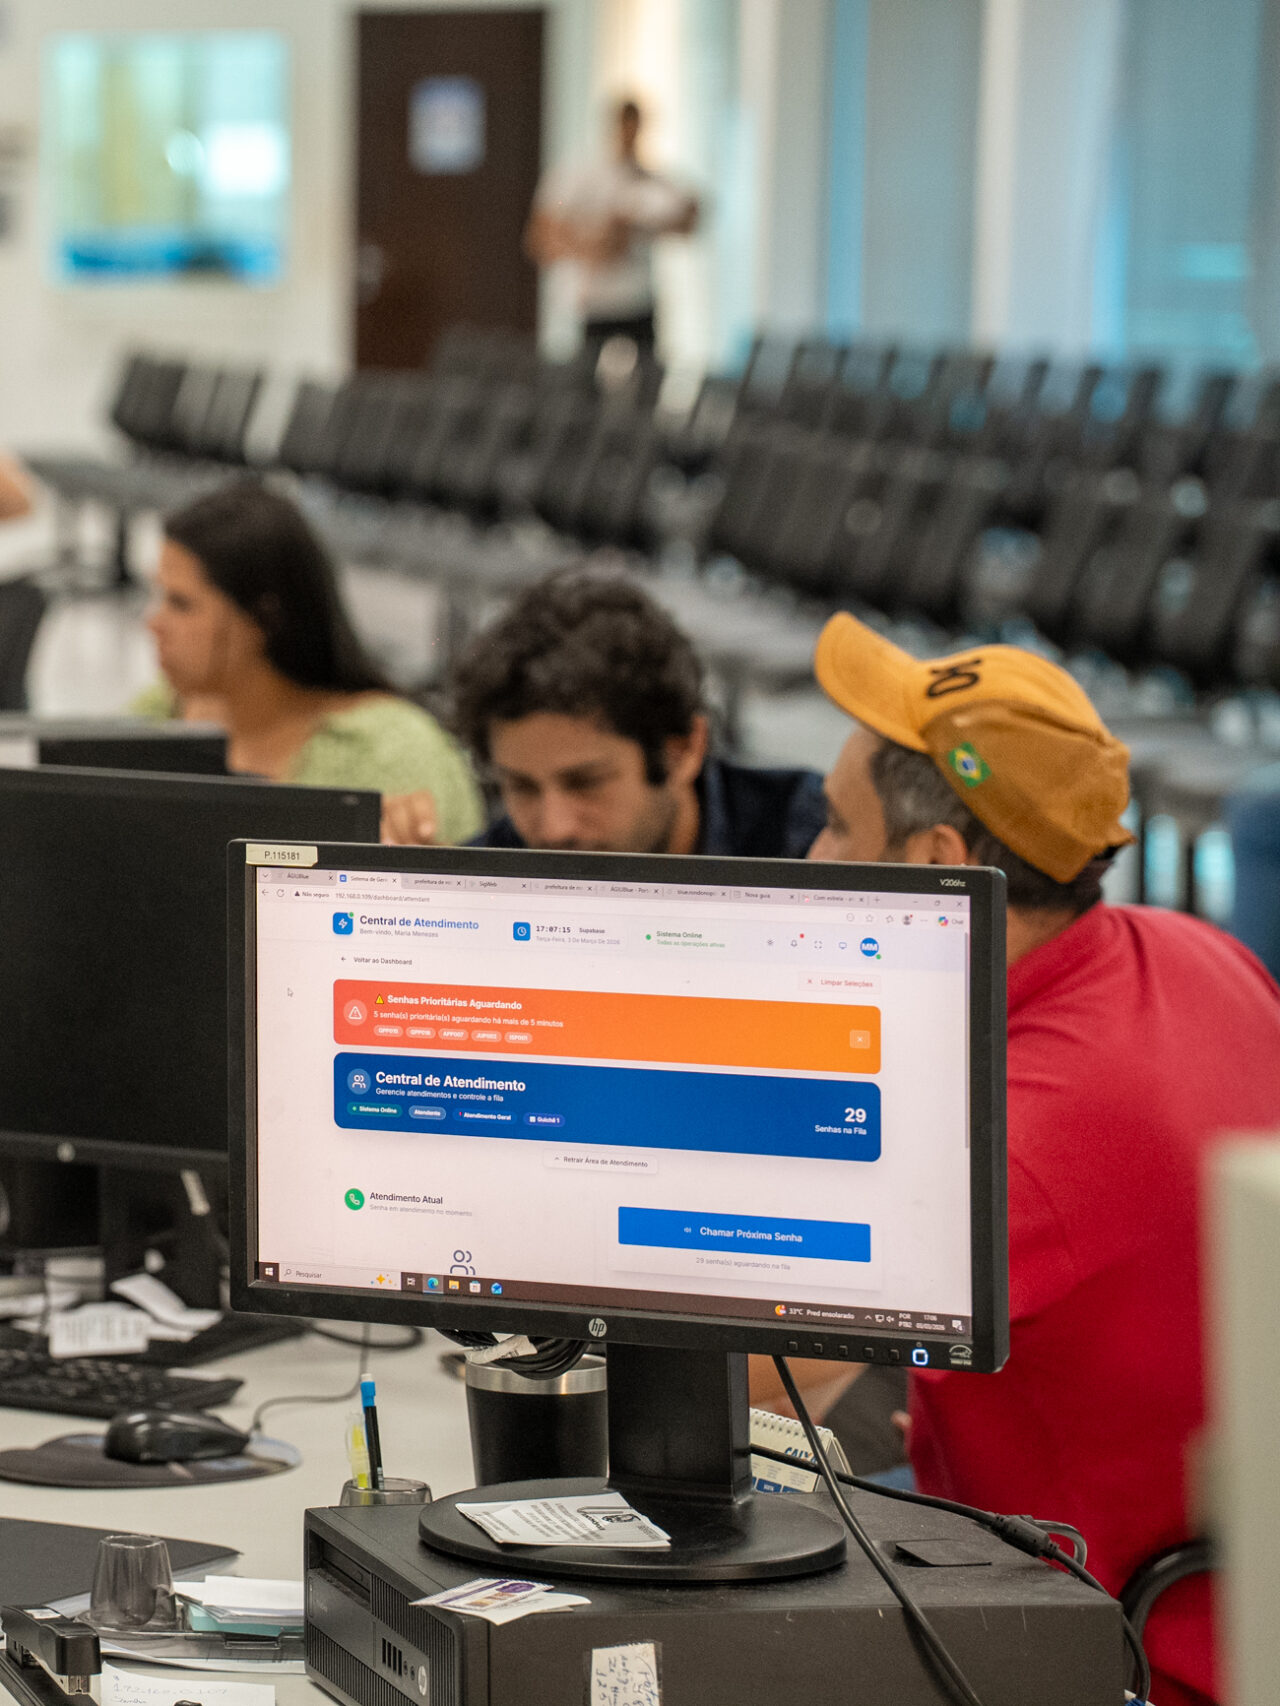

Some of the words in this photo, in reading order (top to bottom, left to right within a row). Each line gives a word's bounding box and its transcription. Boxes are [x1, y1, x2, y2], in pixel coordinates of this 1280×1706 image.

[264, 852, 300, 861] P.115181
[940, 879, 966, 887] V206hz
[360, 915, 397, 926] Central
[399, 917, 412, 927] de
[414, 918, 480, 930] Atendimento
[536, 925, 571, 934] 17:07:15
[821, 979, 842, 987] Limpar
[387, 995, 419, 1005] Senhas
[421, 996, 468, 1007] Prioritárias
[469, 999, 522, 1010] Aguardando
[380, 1011, 409, 1020] senha(s)
[410, 1012, 450, 1022] prioritária(s)
[452, 1016, 492, 1025] aguardando
[376, 1071, 423, 1086] Central
[424, 1074, 441, 1087] de
[443, 1075, 527, 1092] Atendimento
[376, 1087, 406, 1096] Gerencie
[407, 1089, 452, 1099] atendimentos
[458, 1092, 487, 1101] controle
[494, 1094, 504, 1102] fila
[464, 1112, 497, 1120] Atendimento
[497, 1113, 512, 1121] Geral
[844, 1107, 867, 1123] 29
[815, 1124, 842, 1134] Senhas
[843, 1127, 853, 1135] na
[853, 1127, 868, 1136] Fila
[564, 1156, 584, 1164] Retrair
[585, 1157, 599, 1165] Área
[610, 1159, 649, 1168] Atendimento
[369, 1192, 421, 1204] Atendimento
[422, 1195, 444, 1205] Atual
[700, 1226, 735, 1238] Chamar
[736, 1229, 773, 1241] Próxima
[775, 1232, 803, 1243] Senha
[296, 1271, 322, 1279] Pesquisar
[822, 1311, 855, 1320] ensolarado
[590, 1318, 606, 1337] hp
